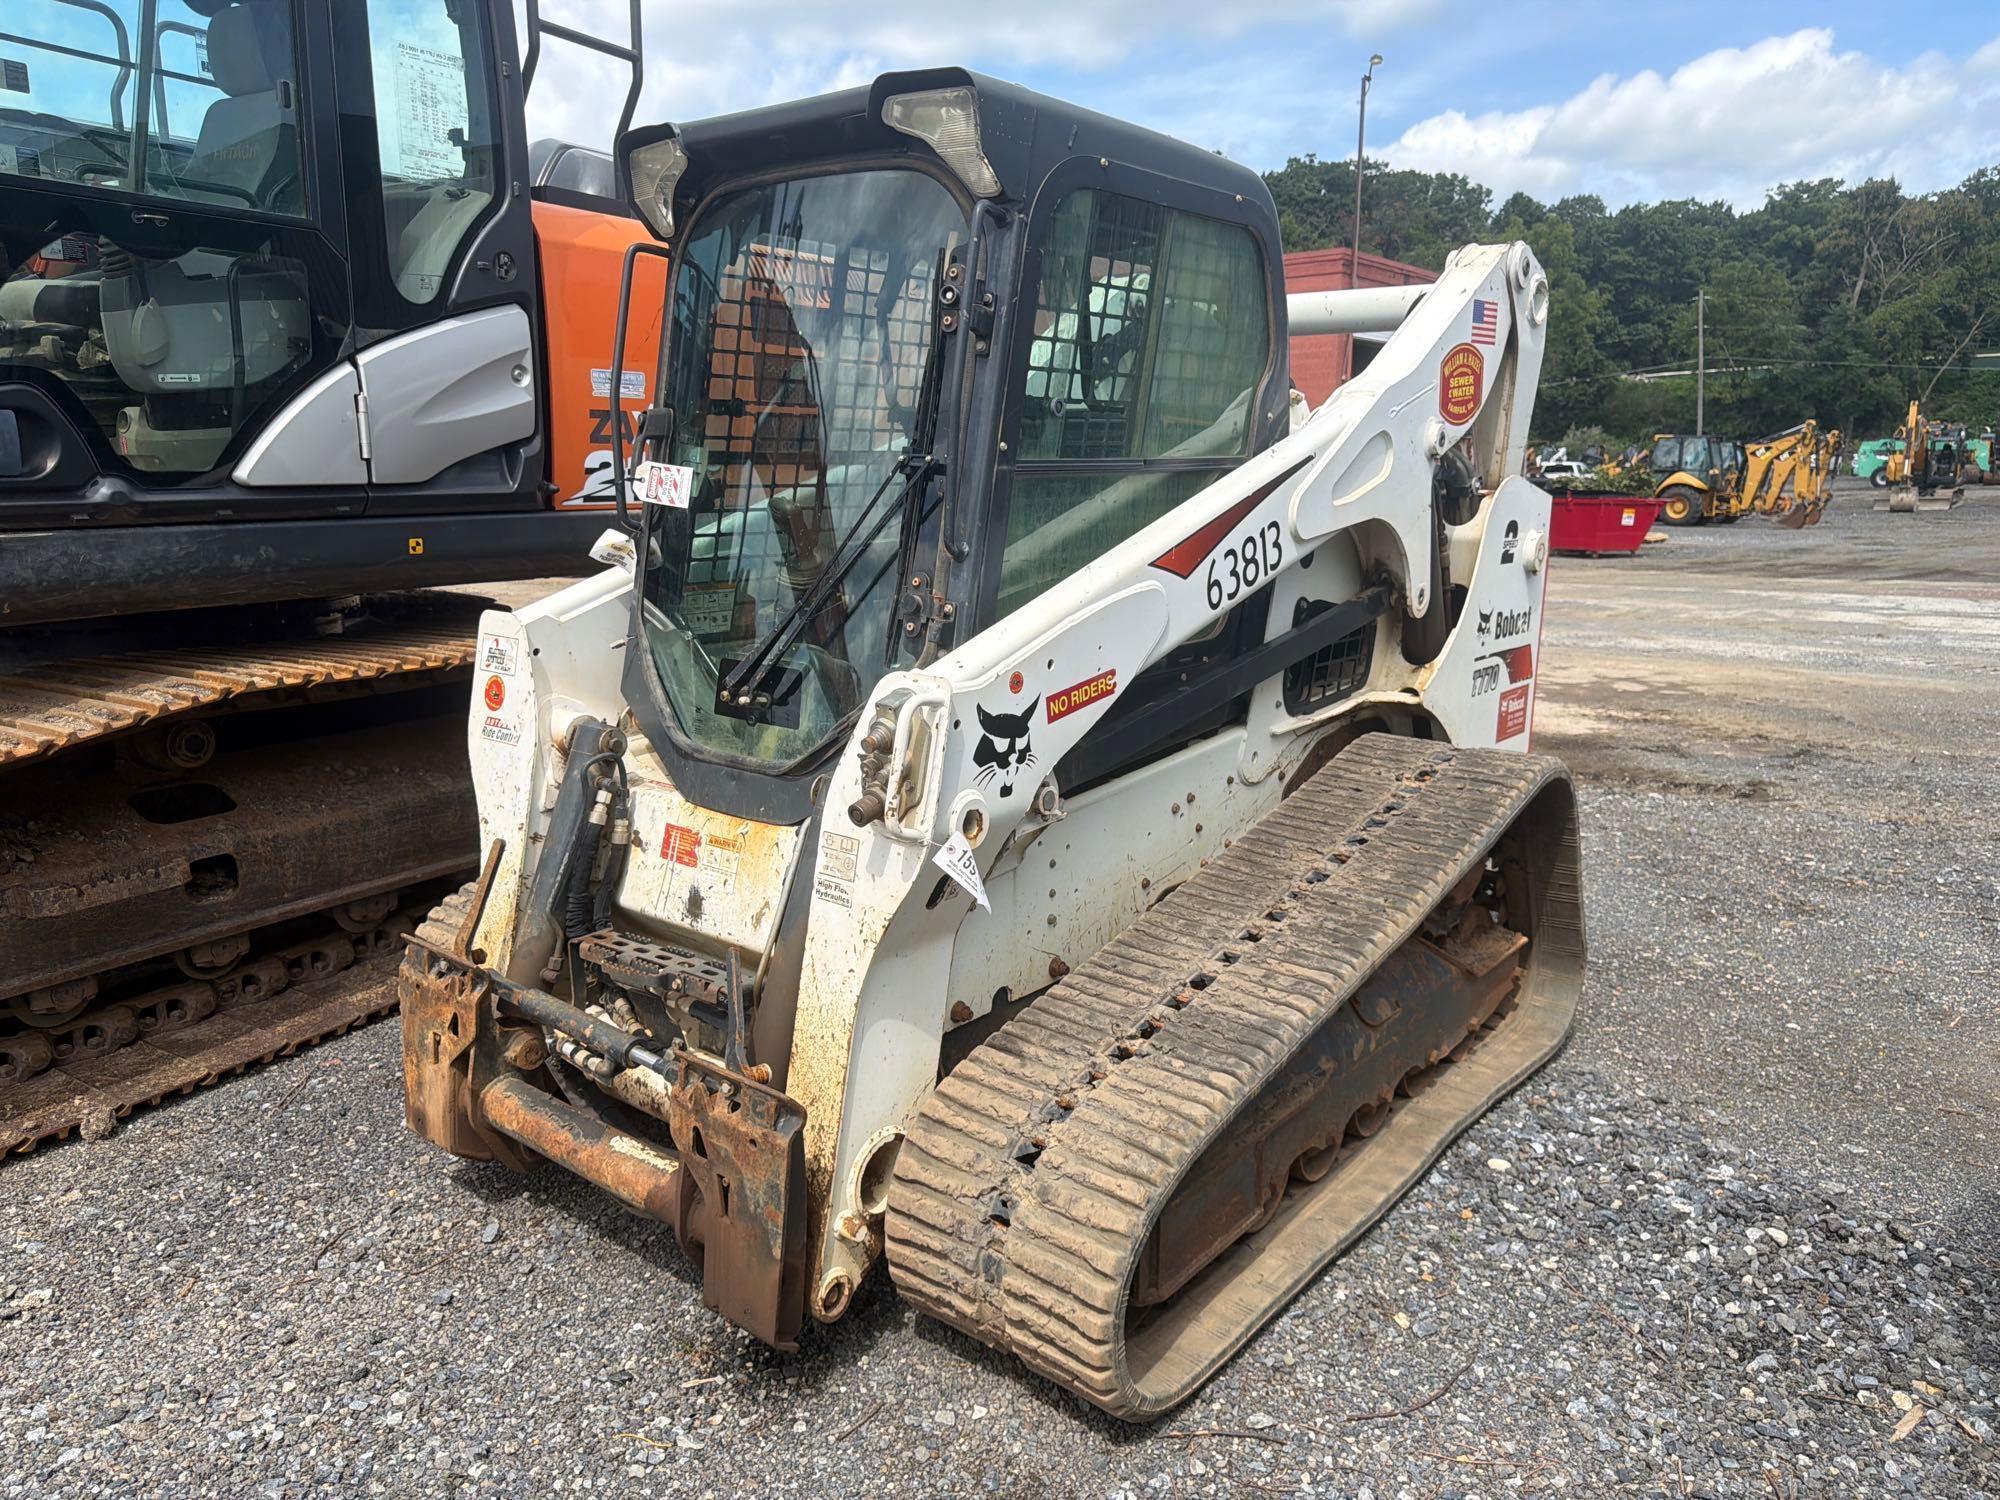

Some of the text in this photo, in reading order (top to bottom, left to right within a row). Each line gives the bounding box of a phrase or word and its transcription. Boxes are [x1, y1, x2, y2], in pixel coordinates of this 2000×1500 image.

[1449, 376, 1475, 388] SEWER
[1452, 386, 1475, 398] WATER
[1207, 520, 1282, 611] 63813
[1495, 606, 1531, 640] Bobcat
[1050, 674, 1114, 717] NO RIDERS
[817, 880, 833, 891] High
[815, 888, 850, 905] Hydraulics
